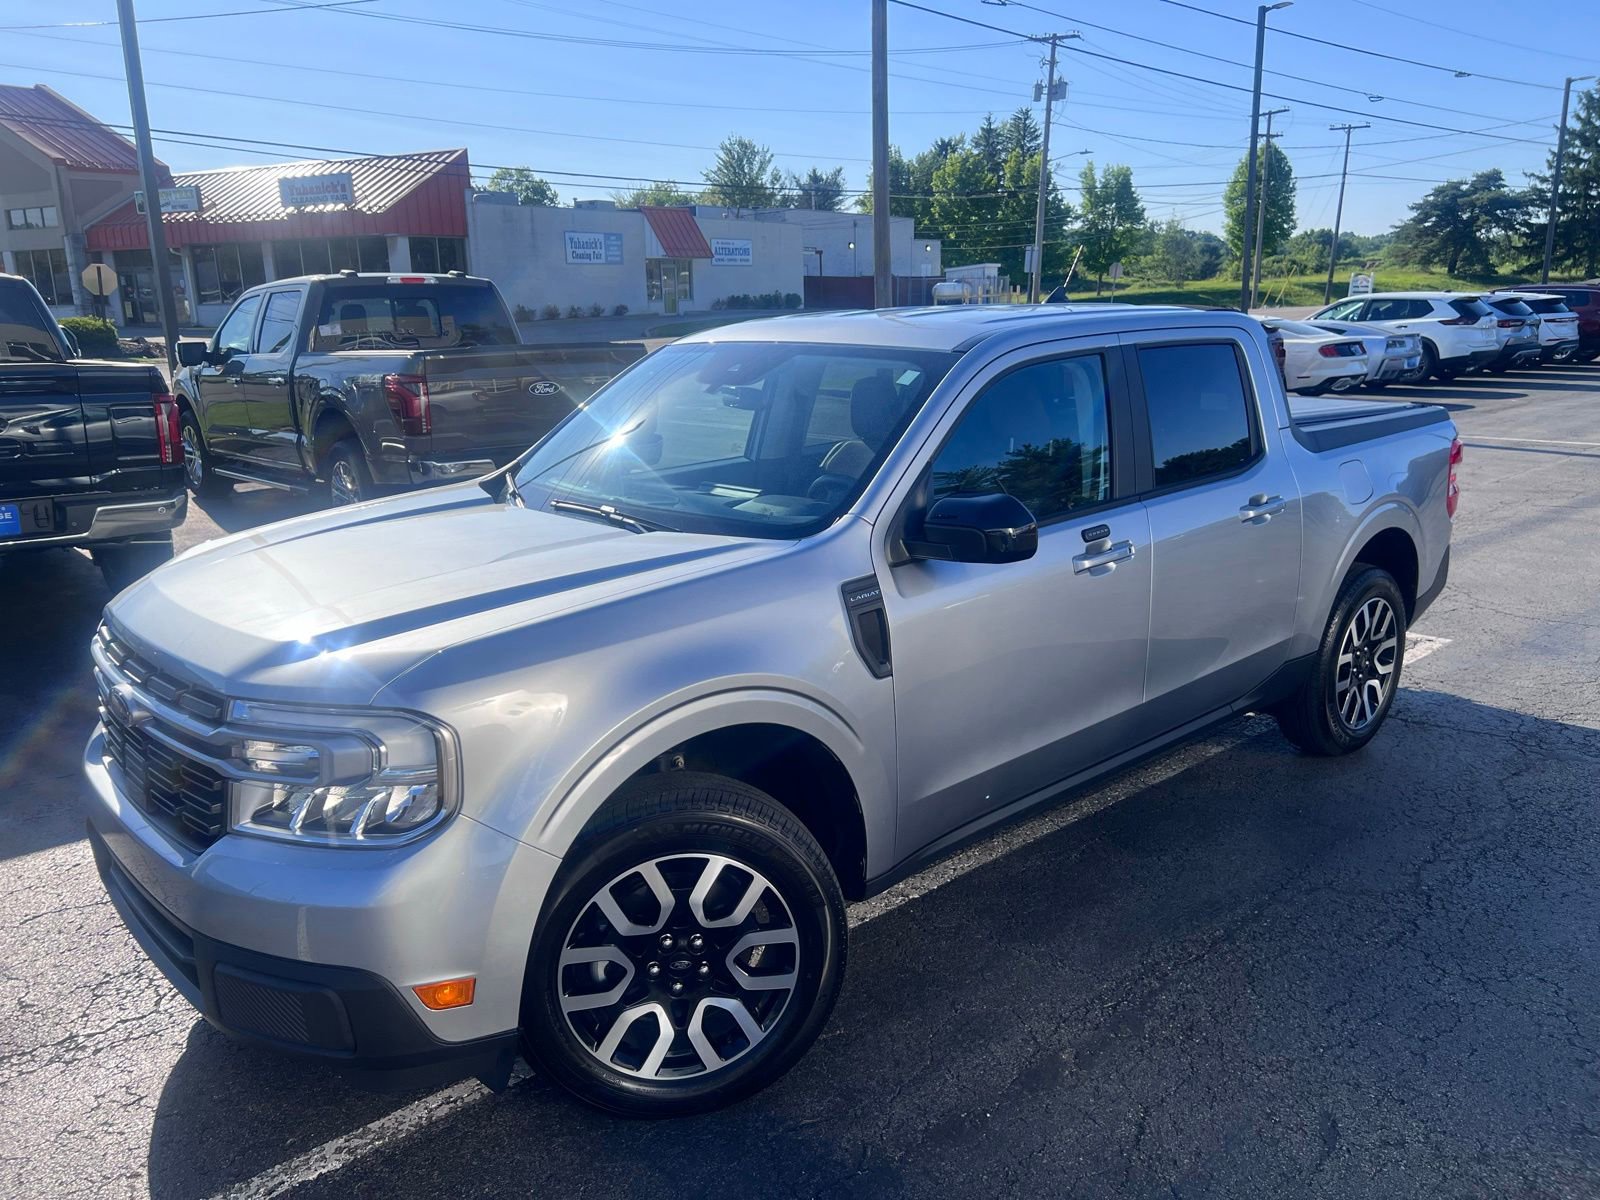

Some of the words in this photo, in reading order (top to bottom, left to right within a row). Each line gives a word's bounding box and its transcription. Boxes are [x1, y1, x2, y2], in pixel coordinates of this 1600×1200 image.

[331, 194, 348, 202] FAIR
[569, 237, 602, 250] Yuhanick's
[572, 250, 591, 261] Cleaning
[593, 250, 602, 260] Fair
[714, 246, 750, 257] ALTERATIONS
[534, 383, 555, 394] Ford
[850, 590, 880, 602] LARIAT
